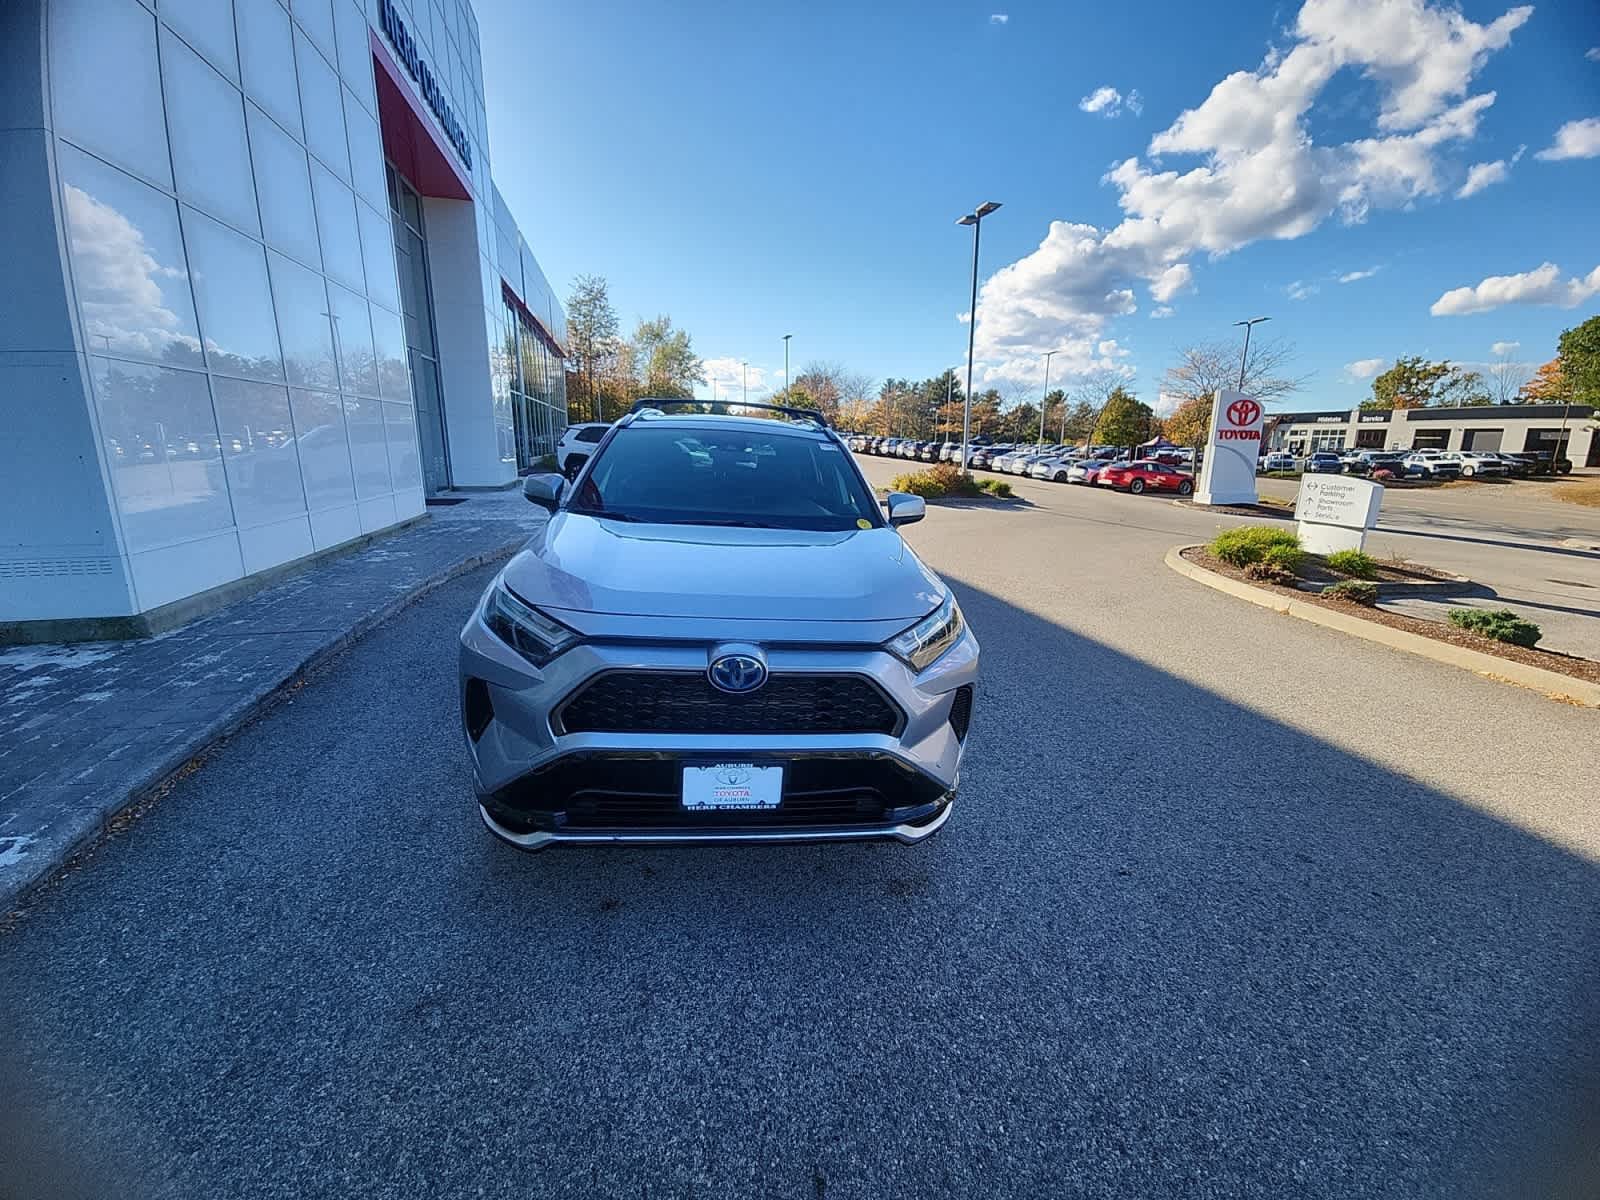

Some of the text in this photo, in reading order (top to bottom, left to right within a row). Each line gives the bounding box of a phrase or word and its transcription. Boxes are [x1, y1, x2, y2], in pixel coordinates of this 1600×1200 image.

[1218, 429, 1261, 440] TOYOTA
[1320, 483, 1355, 492] Customer
[1319, 490, 1346, 499] Parking
